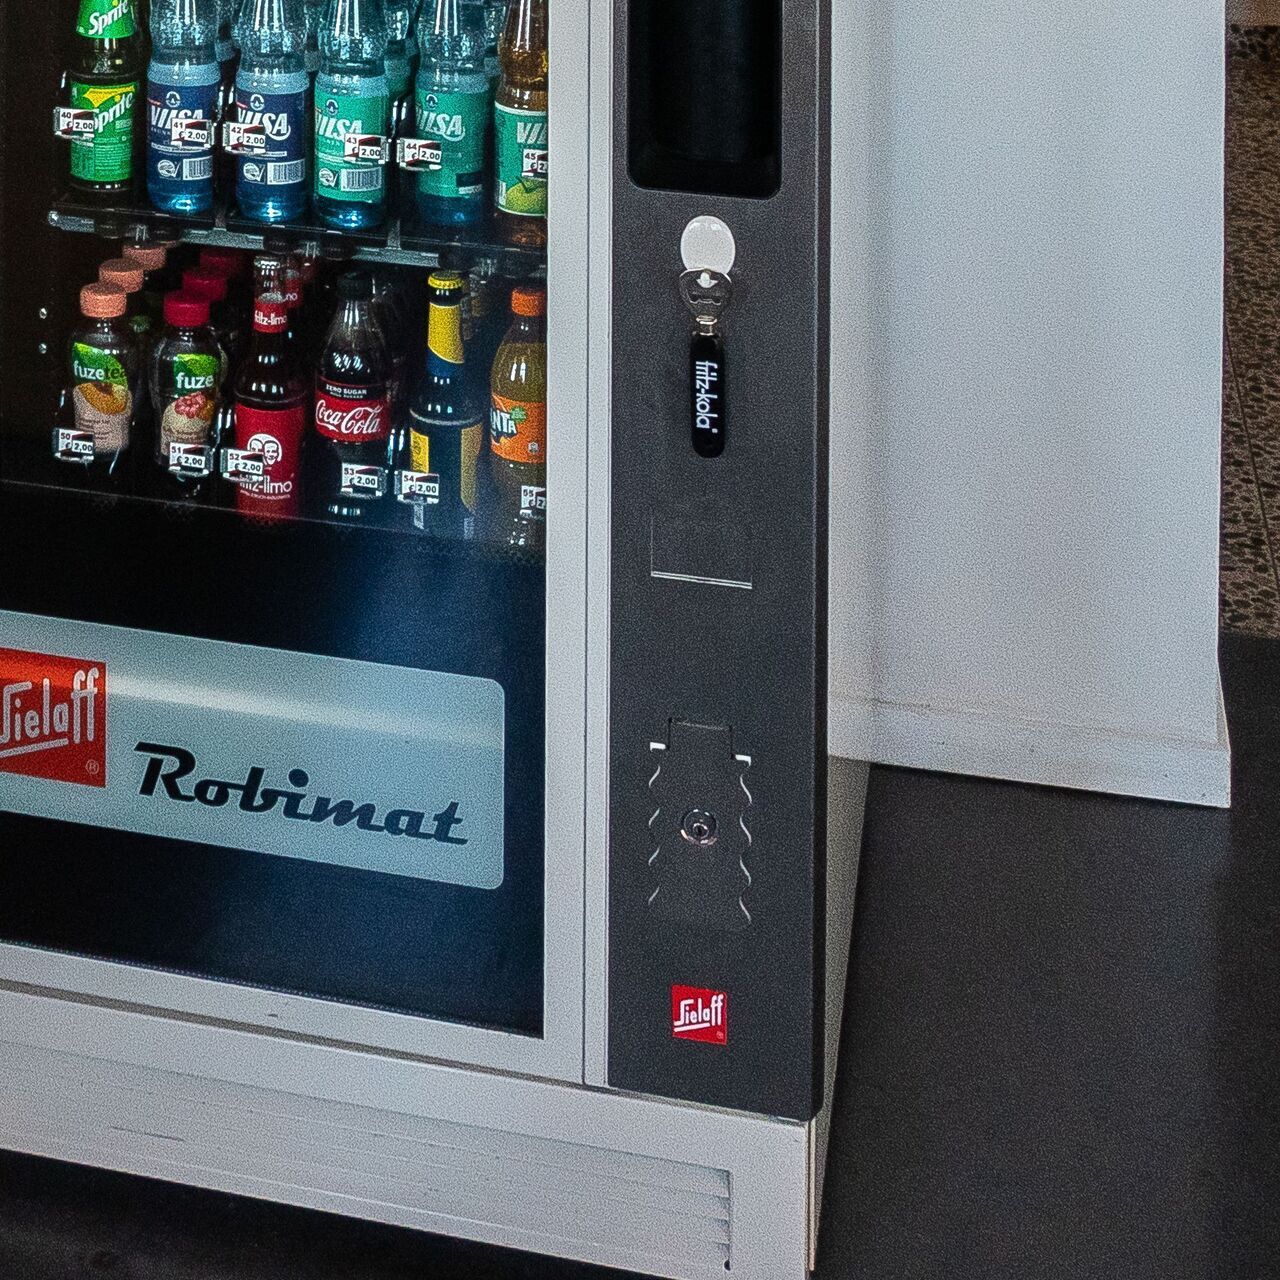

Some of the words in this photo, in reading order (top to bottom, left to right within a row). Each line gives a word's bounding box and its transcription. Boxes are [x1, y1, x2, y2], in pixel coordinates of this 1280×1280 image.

[87, 0, 129, 35] Sprite
[325, 384, 343, 393] ZERO
[343, 387, 367, 396] SUGAR
[696, 361, 718, 429] fritz-kola
[315, 399, 383, 435] Coca-Cola
[490, 409, 517, 434] NTA
[133, 741, 469, 845] Robimat
[673, 994, 724, 1027] Sielaff
